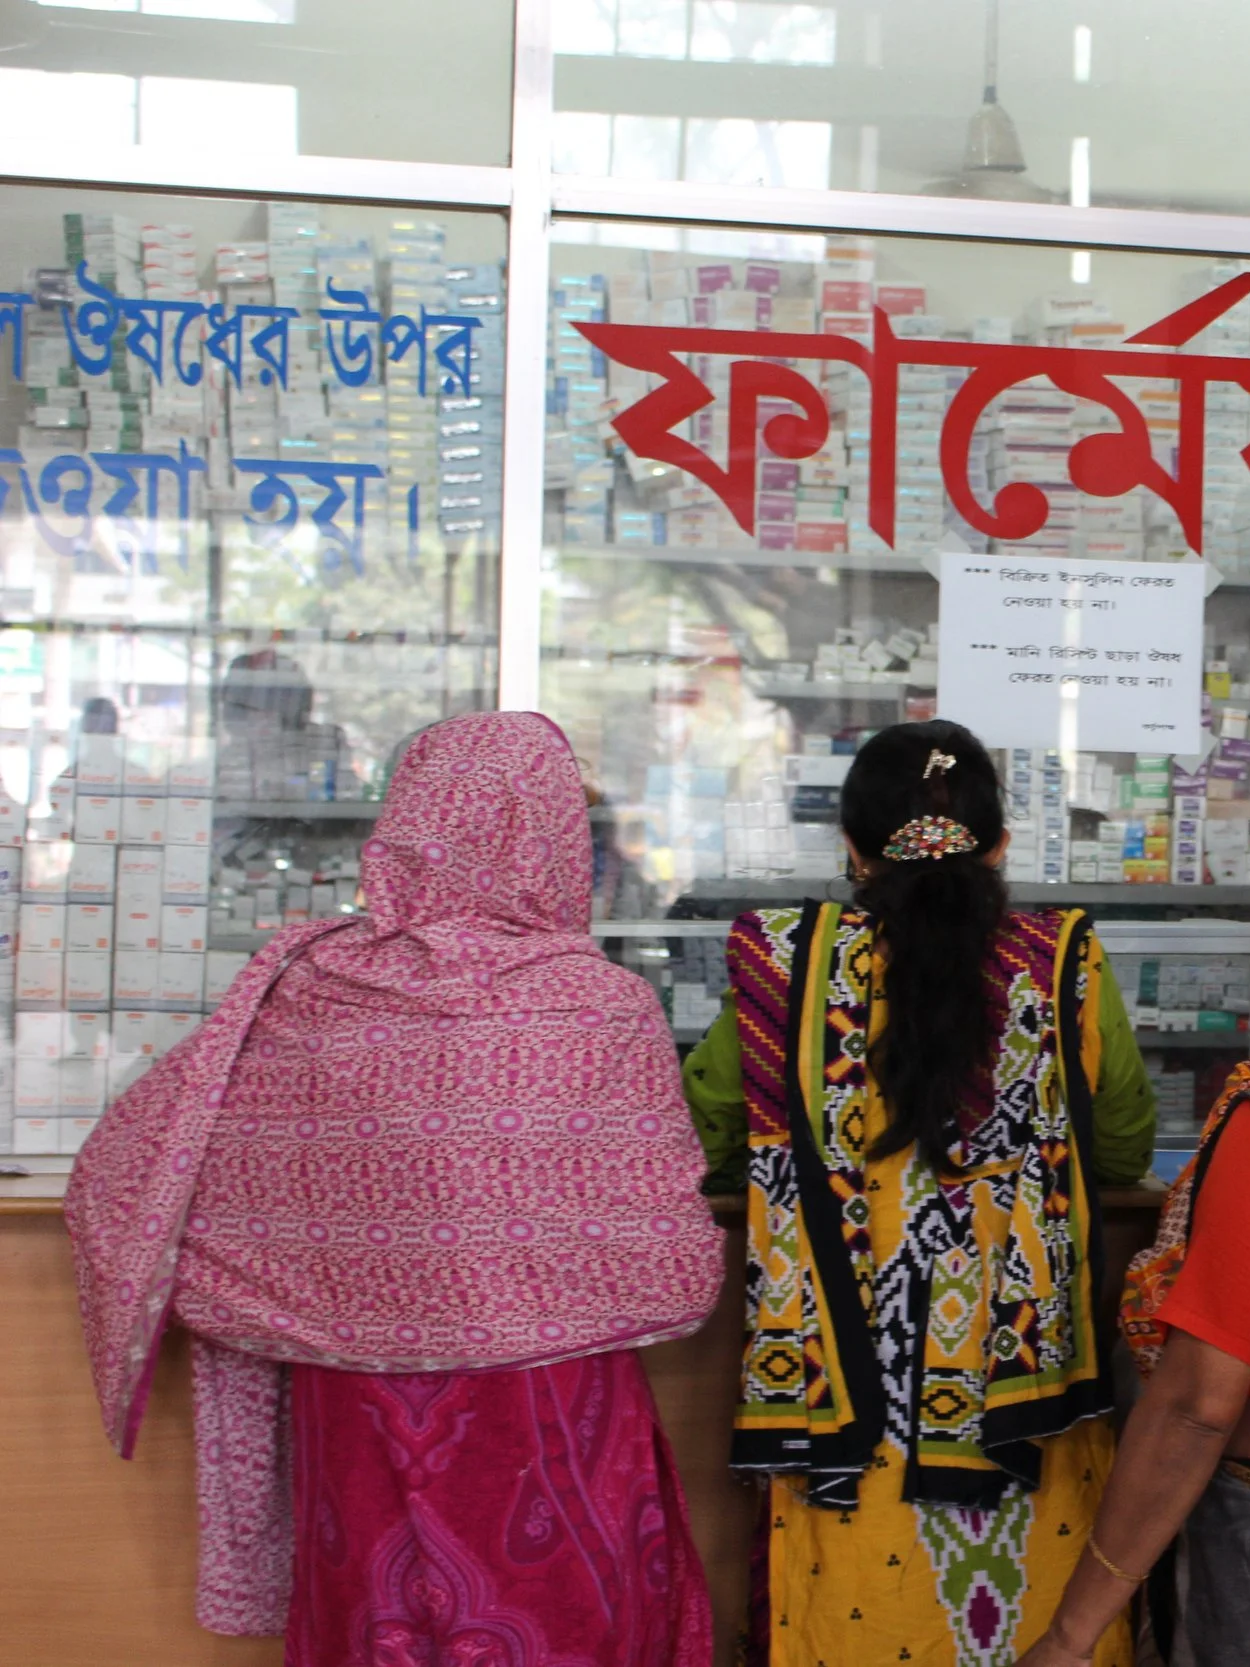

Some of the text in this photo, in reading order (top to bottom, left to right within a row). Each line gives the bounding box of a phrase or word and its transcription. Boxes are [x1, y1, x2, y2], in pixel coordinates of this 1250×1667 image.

[62, 261, 300, 394] ঔষধের
[317, 276, 484, 398] উপর
[1130, 576, 1177, 588] ফেরত
[1002, 596, 1053, 609] নেওয়া
[1005, 644, 1042, 659] মানি
[1008, 672, 1056, 684] ফেরত
